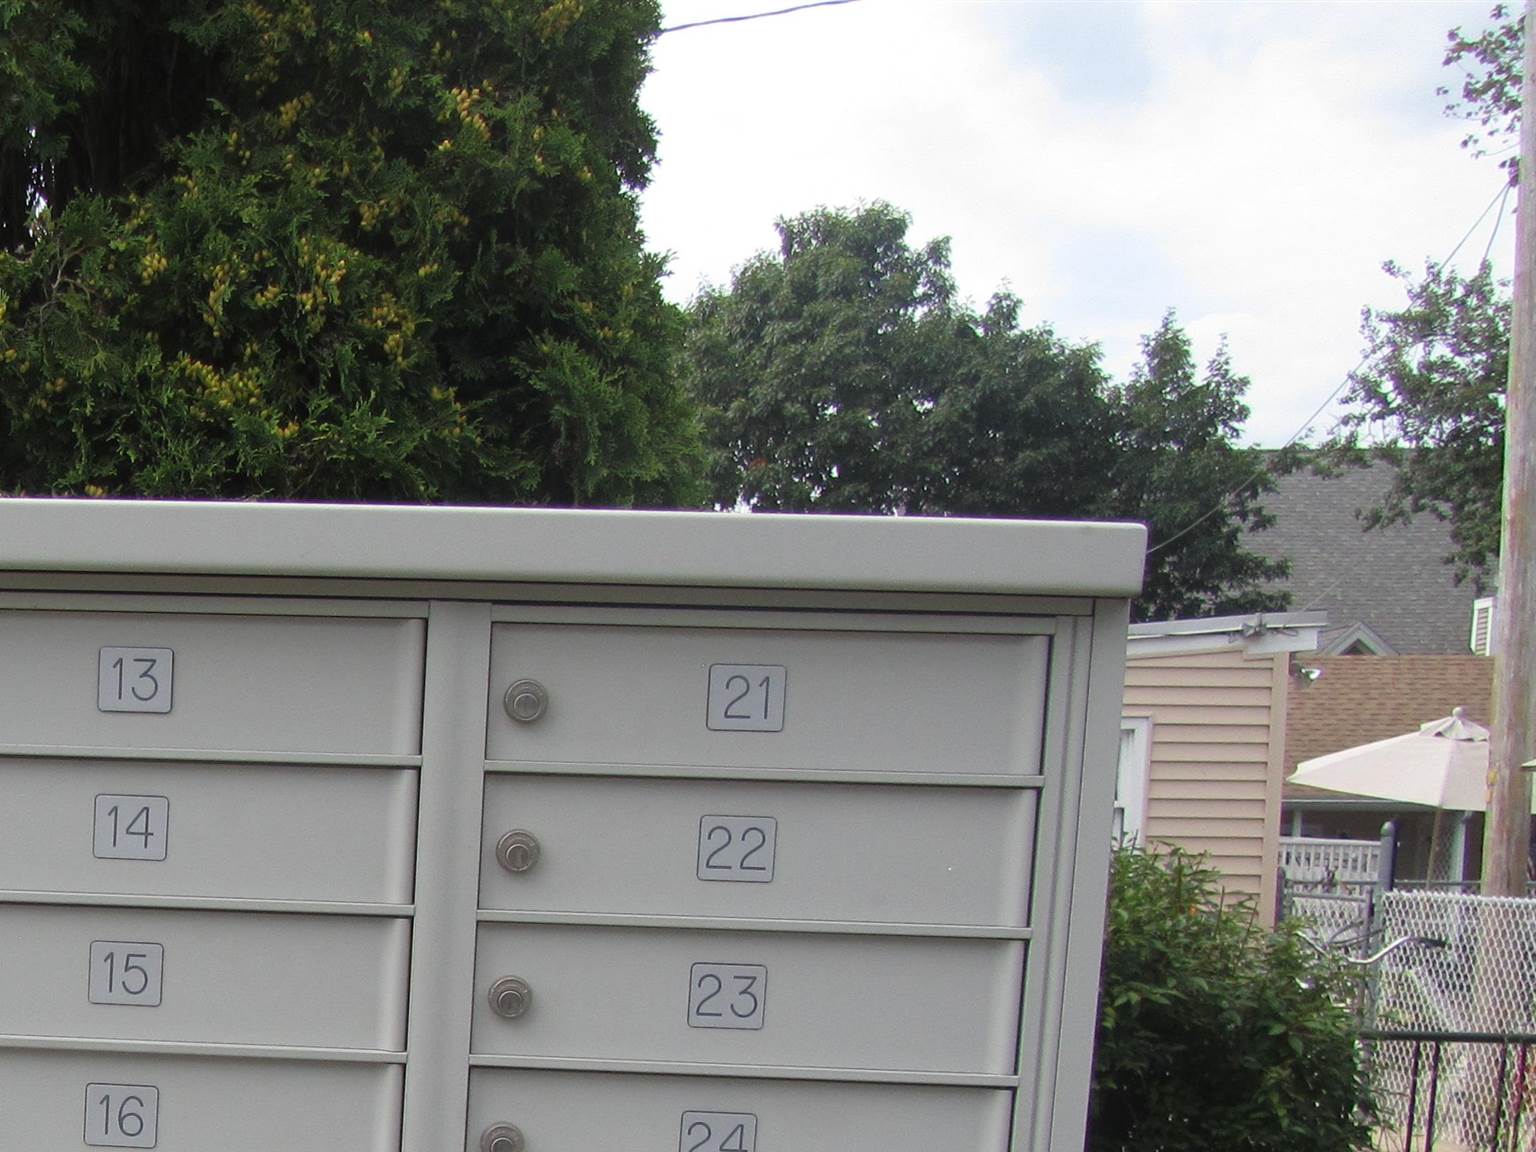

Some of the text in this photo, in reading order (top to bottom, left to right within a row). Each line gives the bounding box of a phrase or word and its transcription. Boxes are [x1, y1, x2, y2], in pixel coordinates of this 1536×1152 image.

[112, 658, 158, 701] 13
[725, 675, 769, 718] 21
[107, 806, 154, 848] 14
[707, 826, 767, 869] 22
[104, 952, 148, 994] 15
[697, 974, 757, 1017] 23
[99, 1096, 143, 1137] 16
